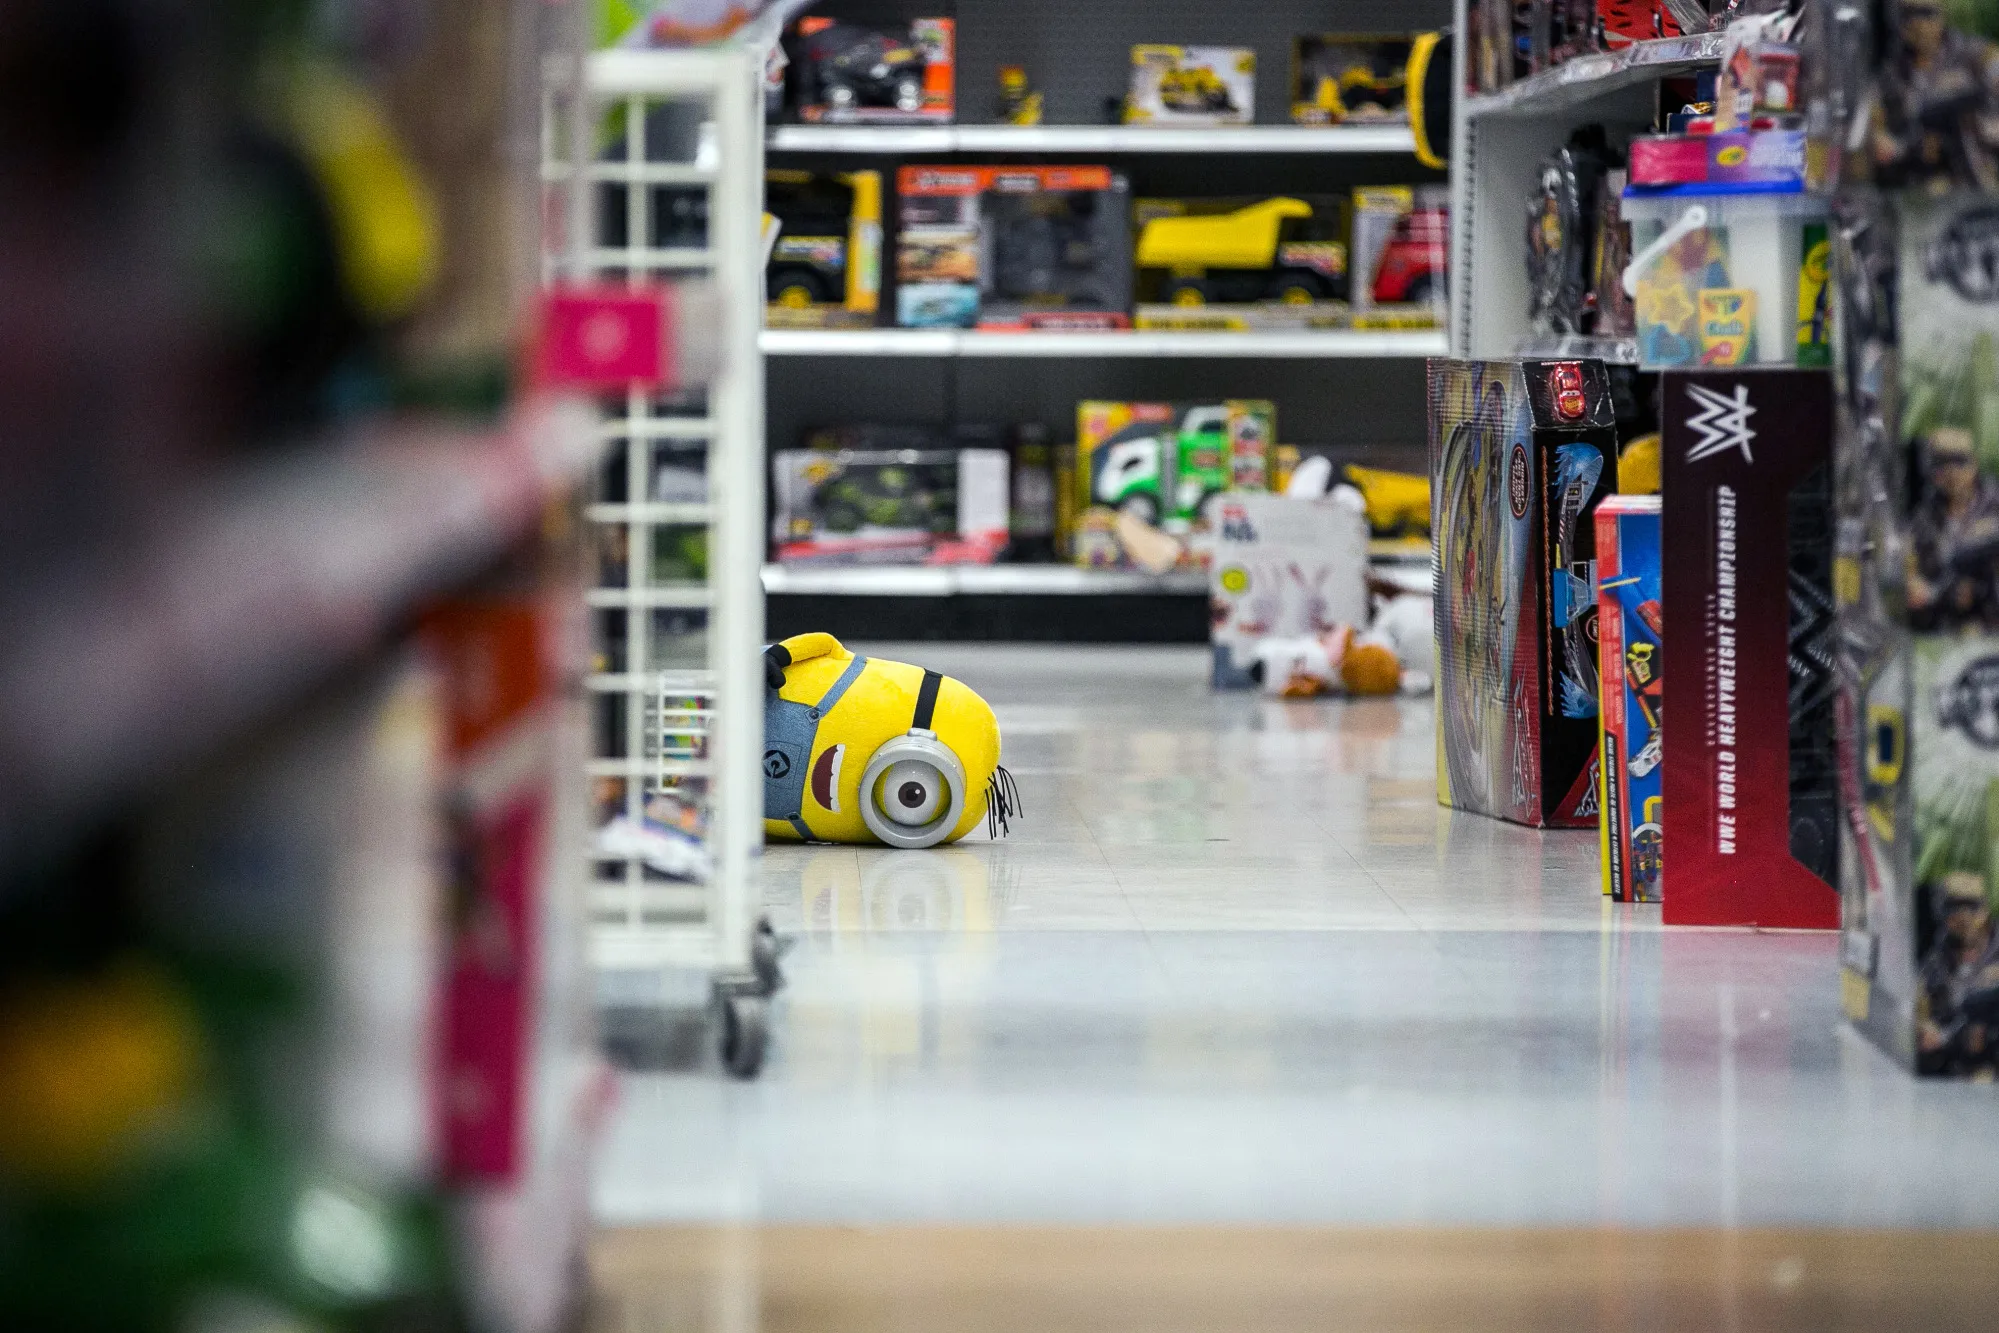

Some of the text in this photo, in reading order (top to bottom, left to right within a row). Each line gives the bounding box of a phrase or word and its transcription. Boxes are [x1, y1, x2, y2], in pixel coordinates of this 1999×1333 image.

[1717, 485, 1737, 855] WWE WORLD HEAVYWEIGHT CHAMPIONSHIP
